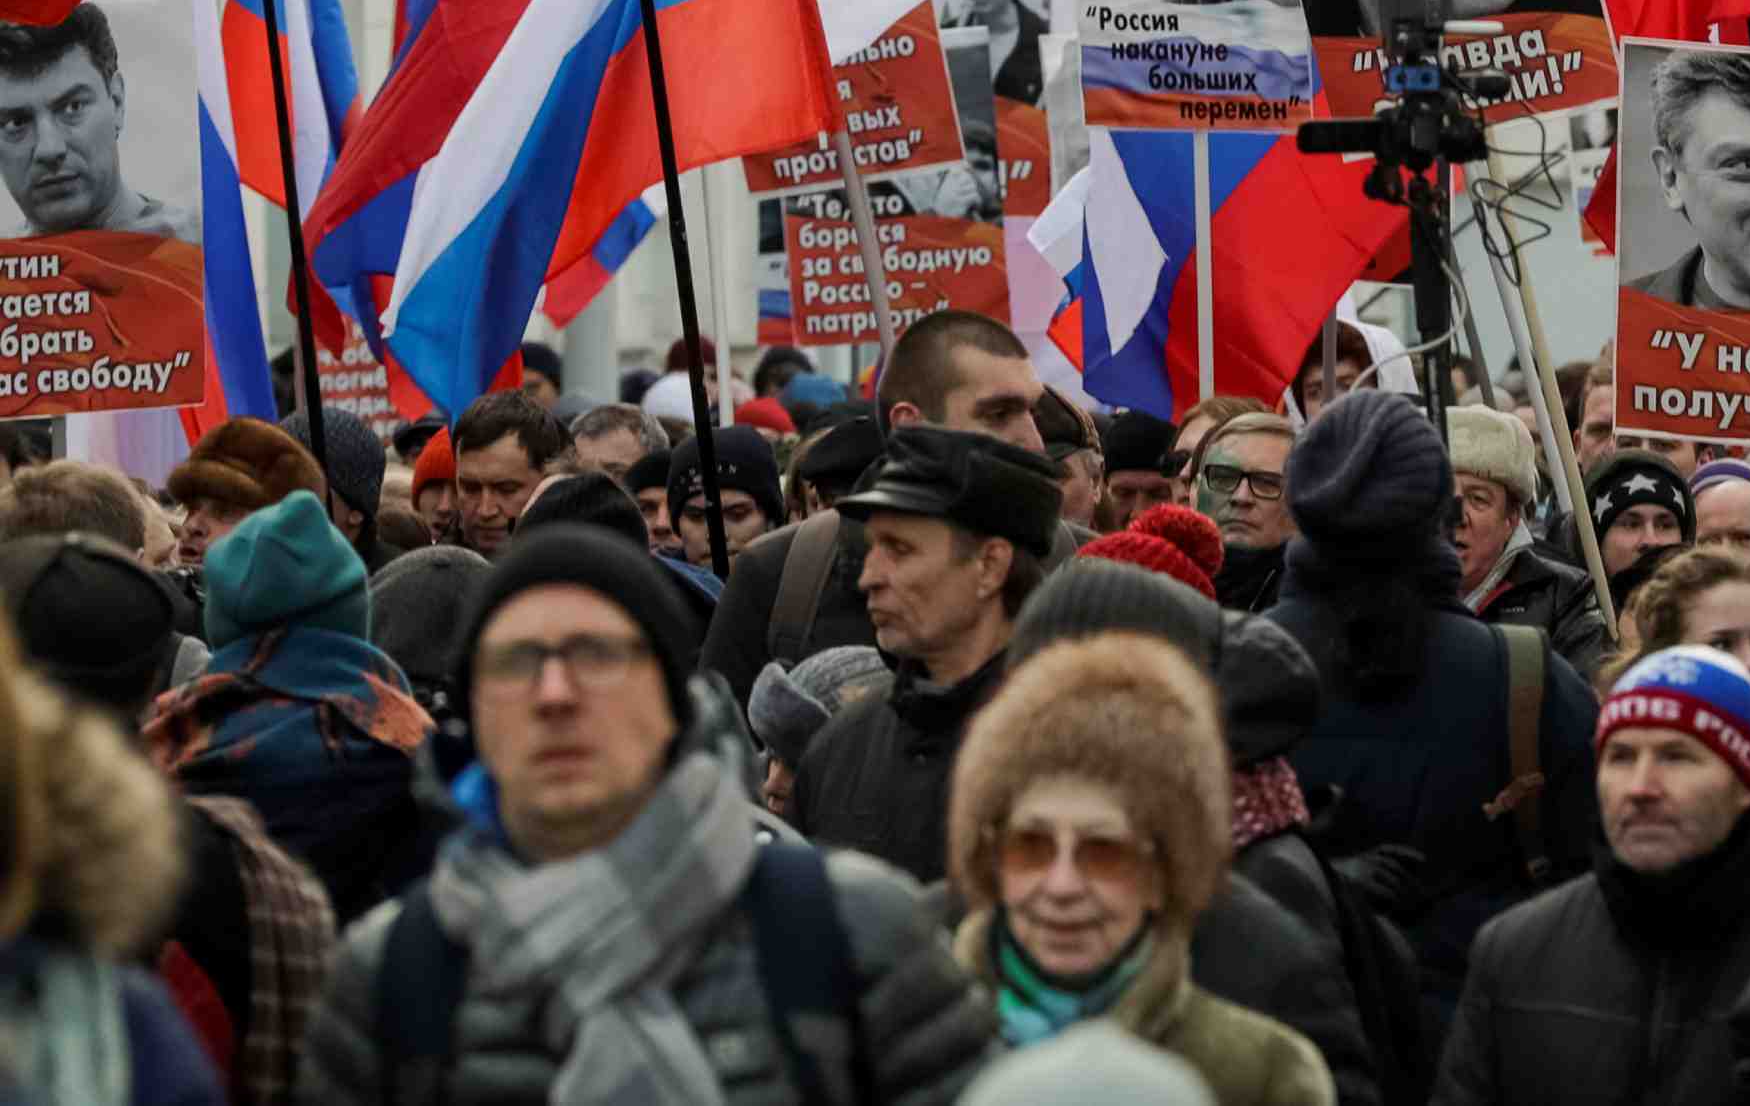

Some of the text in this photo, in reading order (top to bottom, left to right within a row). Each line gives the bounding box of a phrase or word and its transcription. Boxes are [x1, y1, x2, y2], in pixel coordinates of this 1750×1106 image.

[1086, 6, 1179, 32] “Россия
[1111, 41, 1229, 65] накануне
[1148, 64, 1258, 92] больших
[1179, 95, 1300, 125] перемен”
[773, 129, 922, 183] протстов”
[801, 244, 992, 279] за свбодную
[1650, 329, 1705, 370] “У
[37, 350, 192, 394] свободу”
